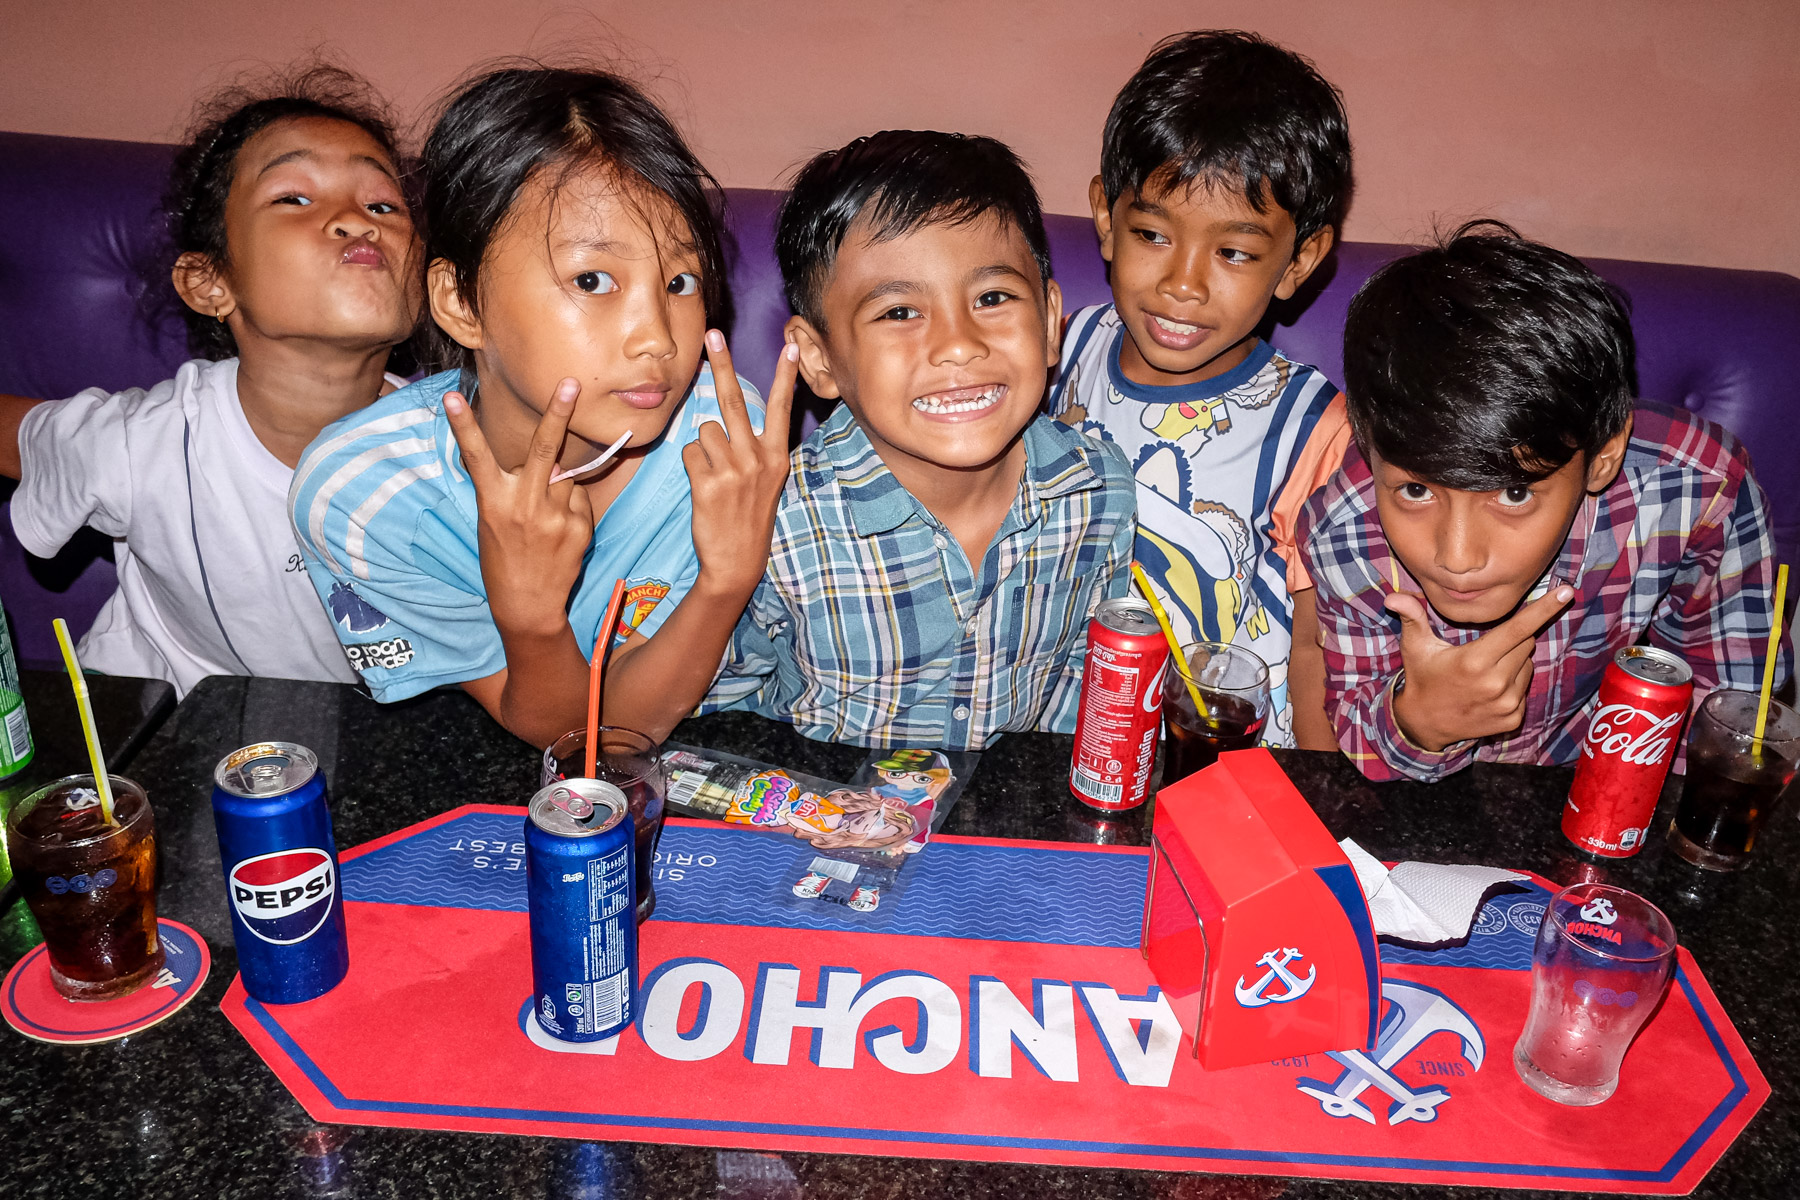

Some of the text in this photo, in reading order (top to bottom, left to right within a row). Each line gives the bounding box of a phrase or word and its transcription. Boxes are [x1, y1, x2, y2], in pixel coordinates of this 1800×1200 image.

[343, 646, 361, 660] o
[350, 658, 364, 671] or
[1588, 704, 1685, 765] Cola
[741, 780, 772, 812] Candy
[234, 867, 332, 909] PEPSI
[1416, 1060, 1466, 1077] SINCE
